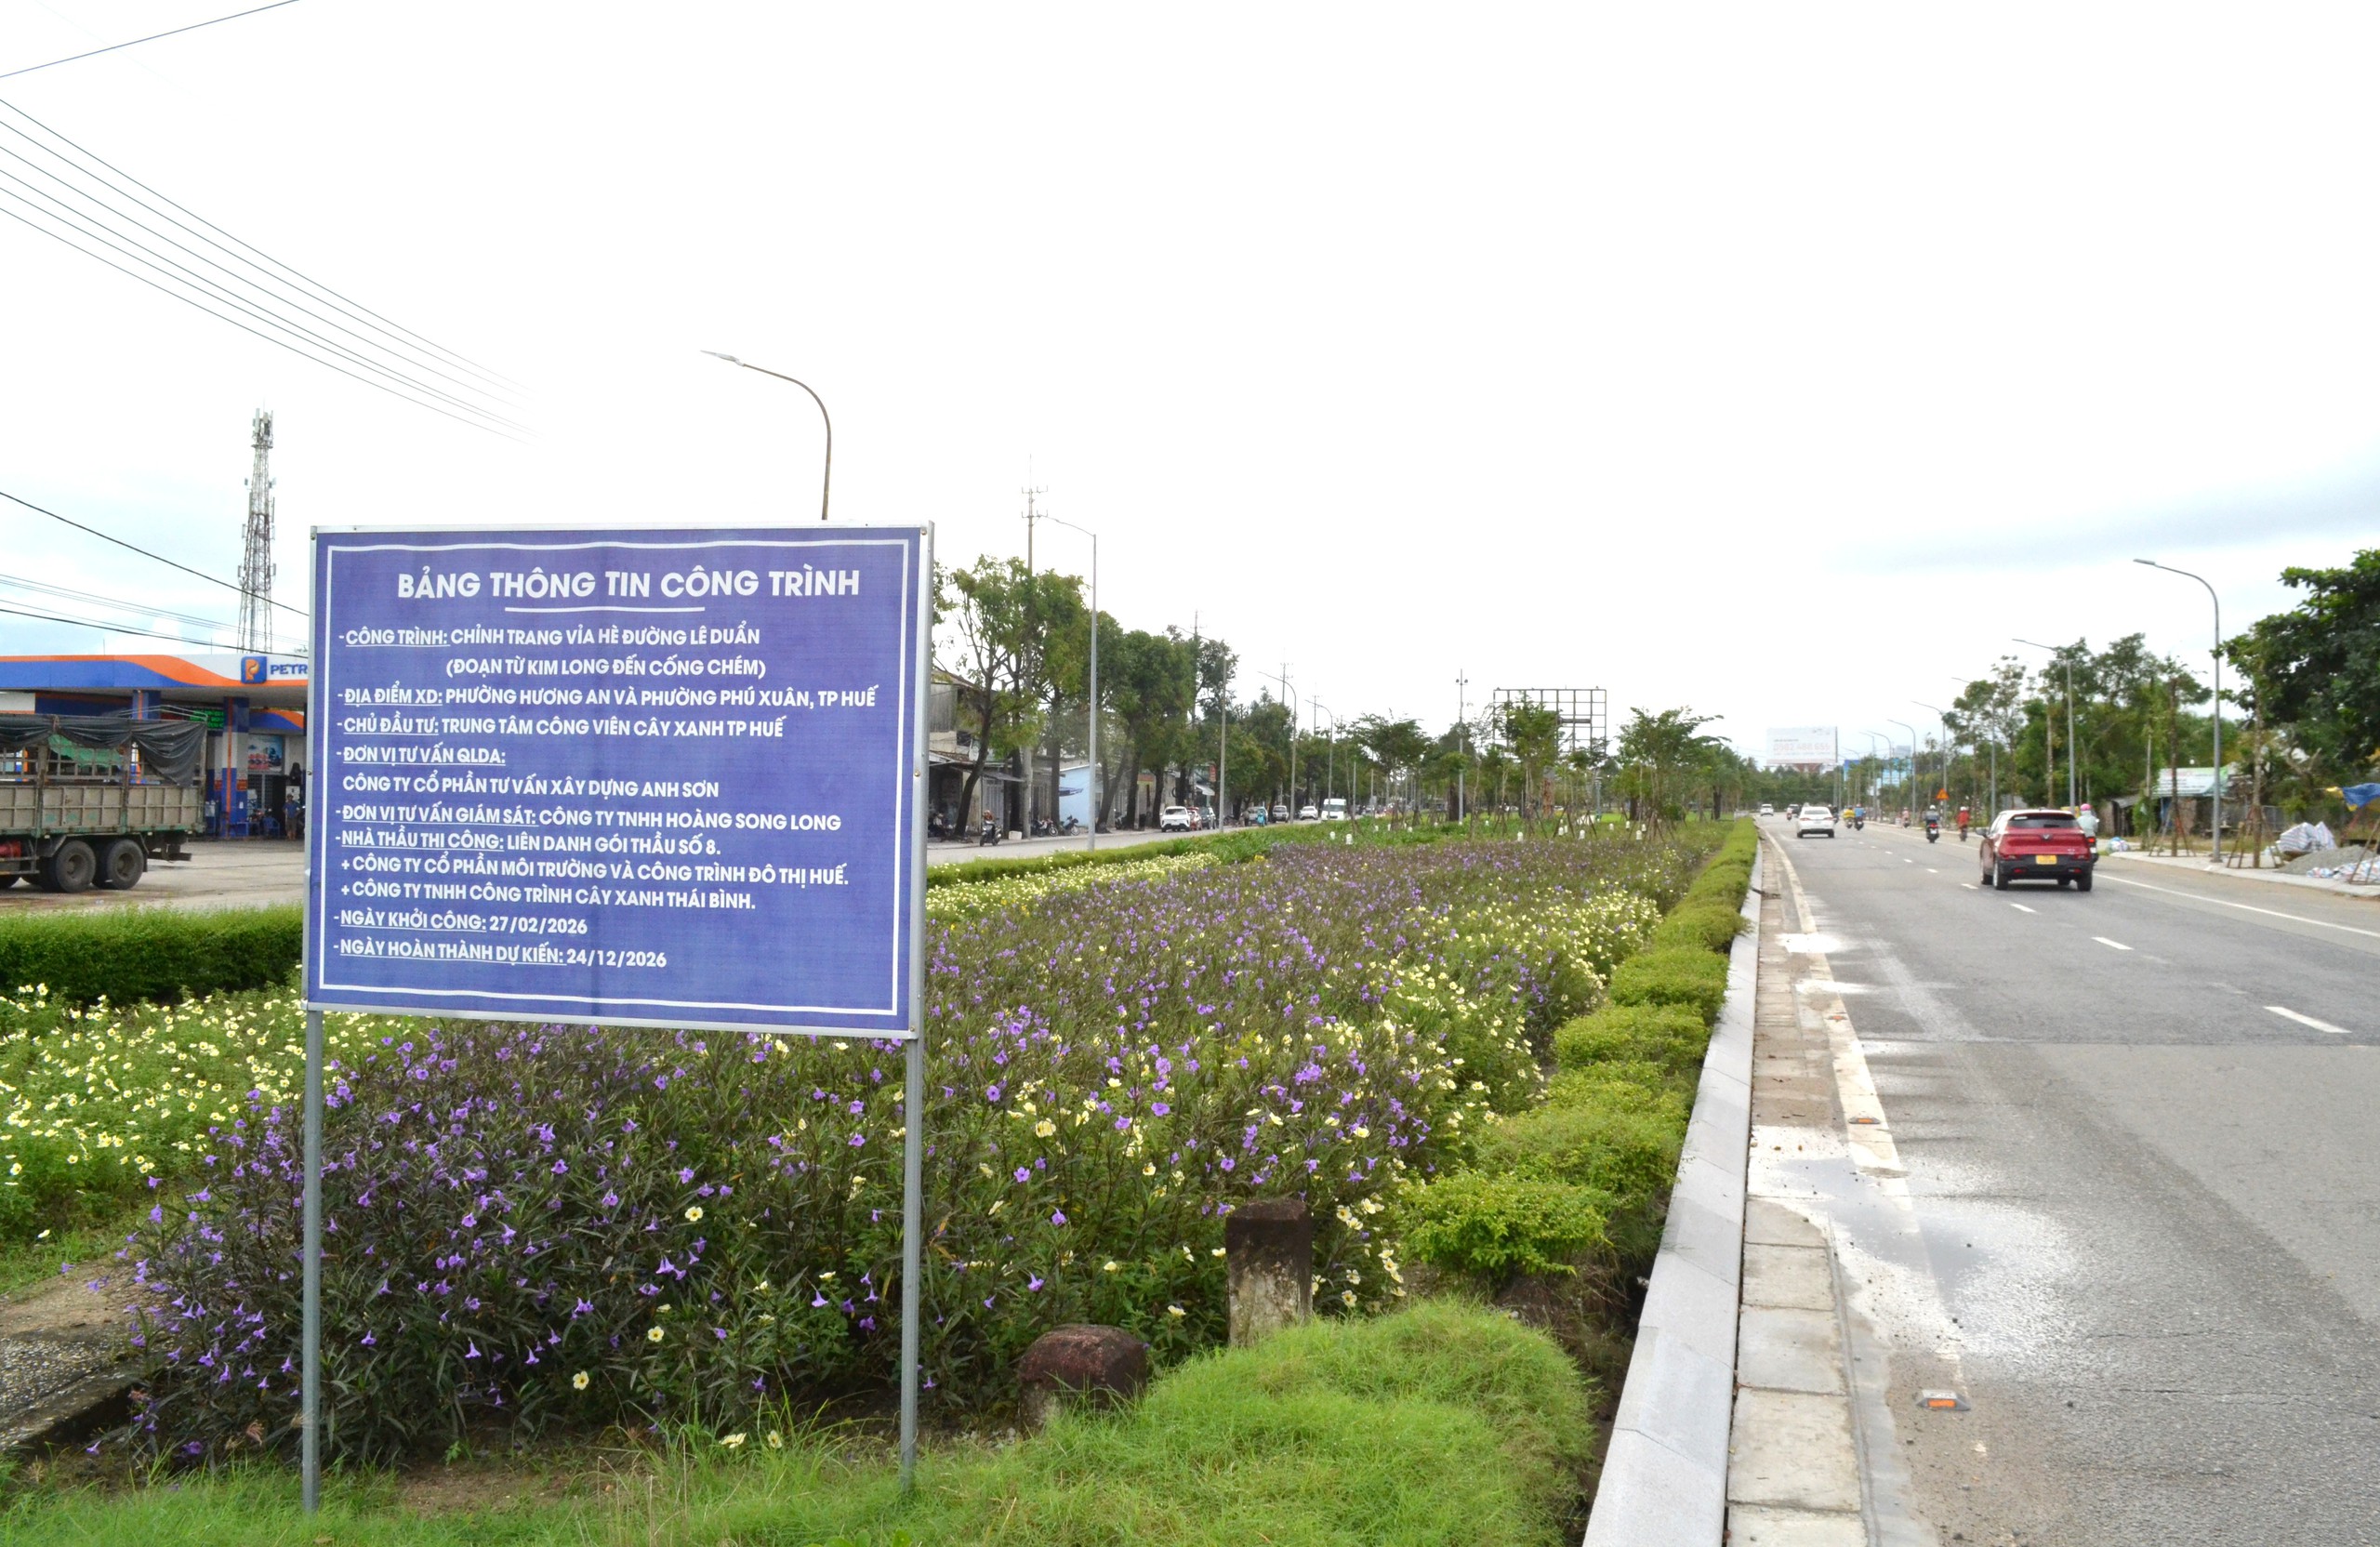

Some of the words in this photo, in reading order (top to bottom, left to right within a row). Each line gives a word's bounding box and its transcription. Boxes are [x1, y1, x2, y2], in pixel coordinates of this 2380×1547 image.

[398, 566, 481, 599] BẢNG
[490, 567, 596, 598] THÔNG
[605, 571, 650, 597] TIN
[661, 565, 759, 598] CÔNG
[769, 563, 859, 596] TRÌNH
[397, 626, 447, 645] TRÌNH:
[451, 624, 504, 644] CHỈNH
[507, 629, 562, 645] TRANG
[566, 624, 595, 644] VỈA
[599, 625, 619, 643] HÈ
[622, 626, 687, 645] ĐƯỜNG
[690, 625, 707, 644] LÊ
[710, 620, 760, 644] DUẨN
[446, 658, 502, 678] (ĐOẠN
[505, 655, 525, 675] TỪ
[527, 660, 558, 675] KIM
[562, 658, 609, 675] LONG
[612, 654, 645, 675] ĐẾN
[649, 654, 704, 676] CỐNG
[707, 654, 766, 680] CHÉM)
[374, 681, 412, 703] ĐIỂM
[415, 689, 443, 704] XD:
[445, 684, 517, 704] PHƯỜNG
[520, 688, 583, 705] HƯƠNG
[585, 689, 610, 705] AN
[614, 686, 638, 706] VÀ
[641, 686, 717, 706] PHƯỜNG
[721, 686, 755, 706] PHÚ
[758, 687, 814, 709] XUÂN,
[817, 691, 839, 707] TP
[841, 684, 879, 707] HUẾ
[379, 710, 413, 733] ĐẦU
[416, 717, 439, 734] TƯ:
[442, 718, 496, 734] TRUNG
[498, 715, 533, 734] TÂM
[536, 716, 589, 734] CÔNG
[592, 716, 630, 735] VIÊN
[633, 717, 671, 736] CÂY
[673, 721, 724, 736] XANH
[727, 721, 747, 736] TP
[749, 715, 787, 737] HUẾ
[380, 747, 396, 766] VỊ
[399, 746, 418, 762] TƯ
[419, 741, 454, 762] VẤN
[456, 747, 506, 763] QLDA:
[343, 773, 390, 791] CÔNG
[393, 776, 411, 792] TY
[414, 770, 439, 792] CỔ
[442, 771, 487, 793] PHẦN
[489, 776, 510, 794] TƯ
[511, 773, 548, 795] VẤN
[550, 775, 586, 795] XÂY
[588, 778, 639, 800] DỰNG
[641, 782, 679, 797] ANH
[682, 780, 719, 798] SƠN
[379, 806, 395, 825] VỊ
[397, 805, 416, 821] TƯ
[418, 800, 453, 822] VẤN
[456, 803, 500, 823] GIÁM
[503, 805, 536, 825] SÁT:
[539, 806, 592, 826] CÔNG
[595, 811, 615, 826] TY
[616, 812, 662, 827] TNHH
[666, 808, 733, 828] HOÀNG
[735, 813, 787, 830] SONG
[790, 814, 841, 831] LONG
[377, 825, 417, 847] THẦU
[420, 833, 444, 848] THI
[448, 829, 503, 849] CÔNG:
[508, 836, 540, 851] LIÊN
[544, 836, 591, 852] DANH
[595, 833, 628, 853] GÓI
[630, 831, 675, 854] THẦU
[679, 833, 703, 854] SỐ
[706, 839, 721, 855] 8.
[352, 853, 402, 872] CÔNG
[403, 858, 421, 873] TY
[424, 851, 450, 873] CỔ
[454, 852, 497, 875] PHẦN
[502, 857, 534, 876] MÔI
[537, 858, 607, 879] TRƯỜNG
[610, 860, 634, 879] VÀ
[637, 861, 692, 881] CÔNG
[694, 862, 745, 882] TRÌNH
[748, 864, 776, 883] ĐÔ
[778, 868, 806, 889] THỊ
[810, 863, 849, 885] HUẾ.
[352, 878, 402, 897] CÔNG
[403, 883, 421, 898] TY
[423, 884, 466, 899] TNHH
[469, 881, 522, 902] CÔNG
[523, 883, 572, 904] TRÌNH
[575, 885, 612, 905] CÂY
[615, 890, 664, 906] XANH
[667, 888, 706, 907] THÁI
[709, 889, 756, 909] BÌNH.
[389, 907, 428, 928] KHỞI
[430, 910, 486, 930] CÔNG:
[489, 916, 588, 934] 27/02/2026
[388, 938, 435, 958] HOÀN
[438, 940, 493, 960] THÀNH
[496, 945, 520, 966] DỰ
[522, 942, 563, 963] KIẾN:
[566, 948, 667, 968] 24/12/2026
